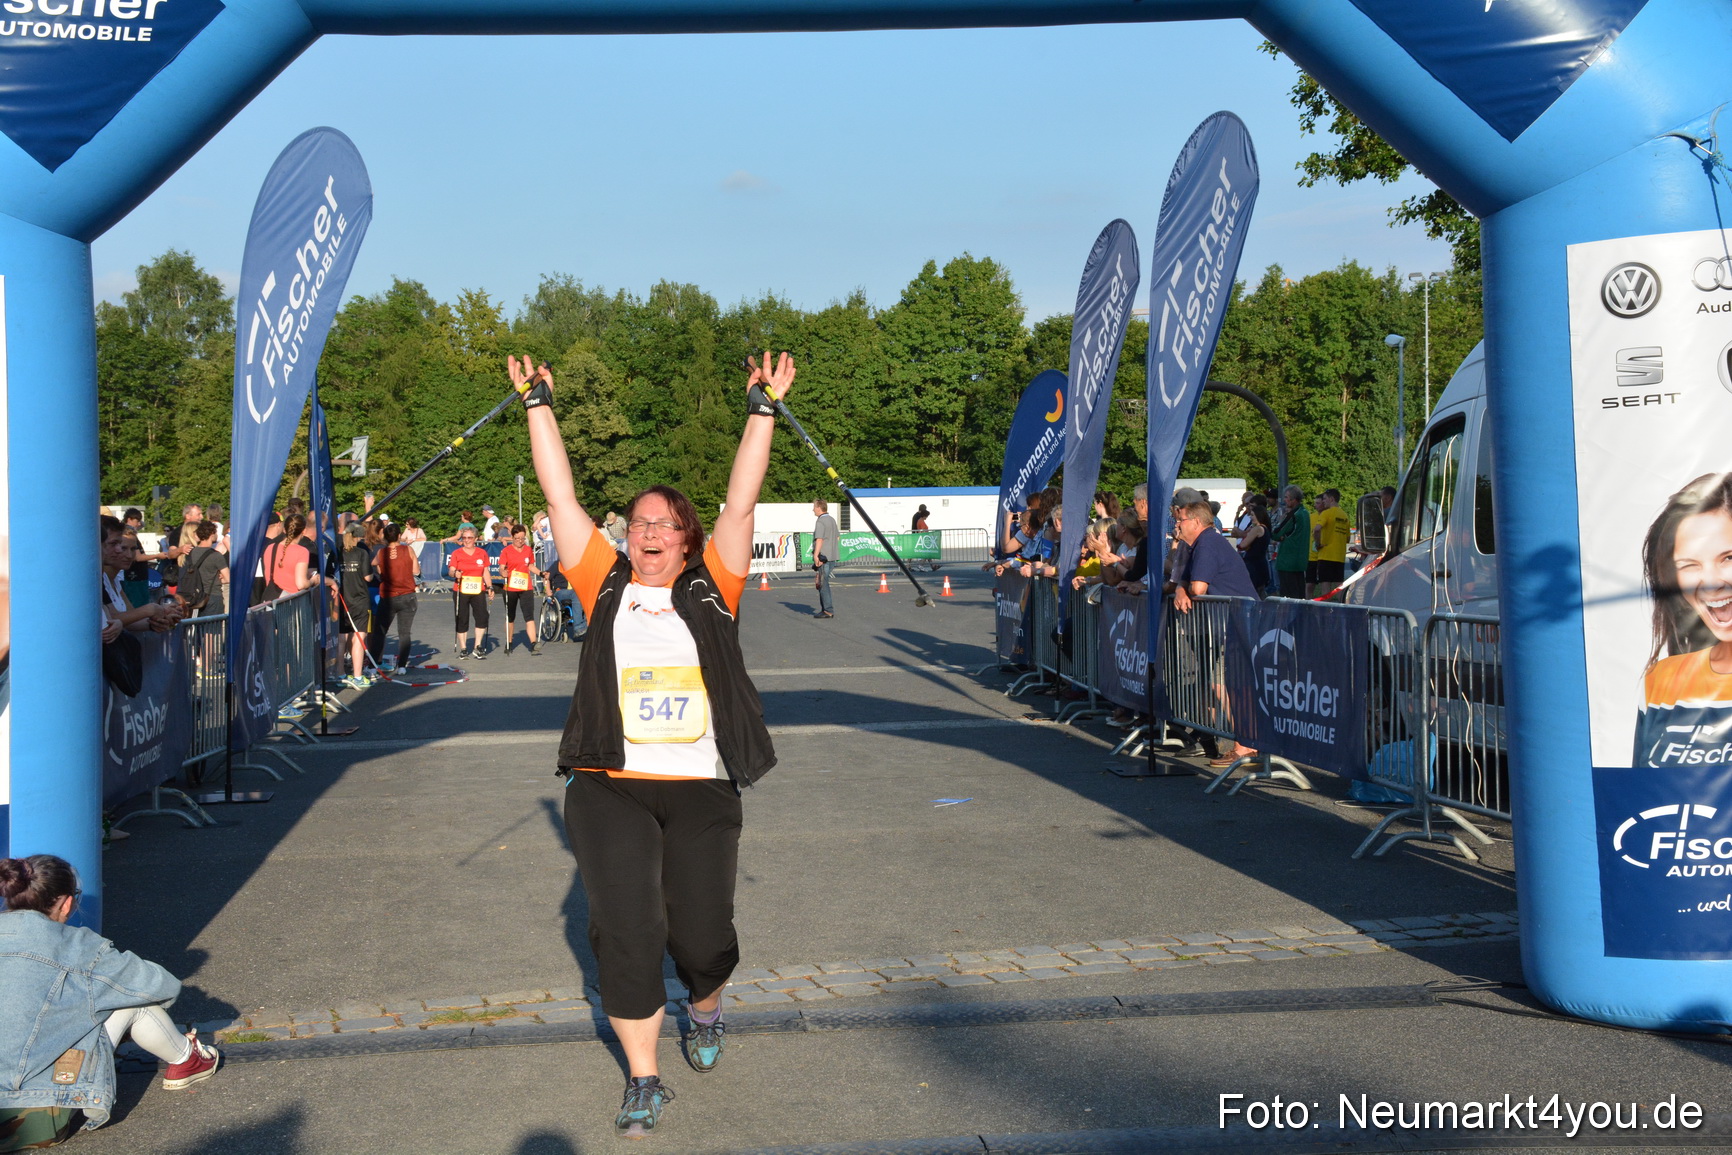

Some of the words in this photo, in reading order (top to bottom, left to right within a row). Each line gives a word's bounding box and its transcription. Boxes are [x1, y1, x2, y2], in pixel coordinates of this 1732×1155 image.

[262, 175, 339, 389] Fischer
[1172, 156, 1232, 374] Fischer
[283, 213, 347, 385] AUTOMOBILE
[1084, 253, 1124, 413] Fischer
[1601, 392, 1682, 409] SEAT
[1002, 426, 1055, 513] Frischmann
[1034, 453, 1049, 476] Druck
[1048, 438, 1060, 455] und
[915, 535, 939, 549] AOK
[513, 578, 526, 586] 266
[638, 697, 690, 721] 547
[1263, 667, 1339, 718] Fischer
[1273, 716, 1336, 745] AUTOMOBILE
